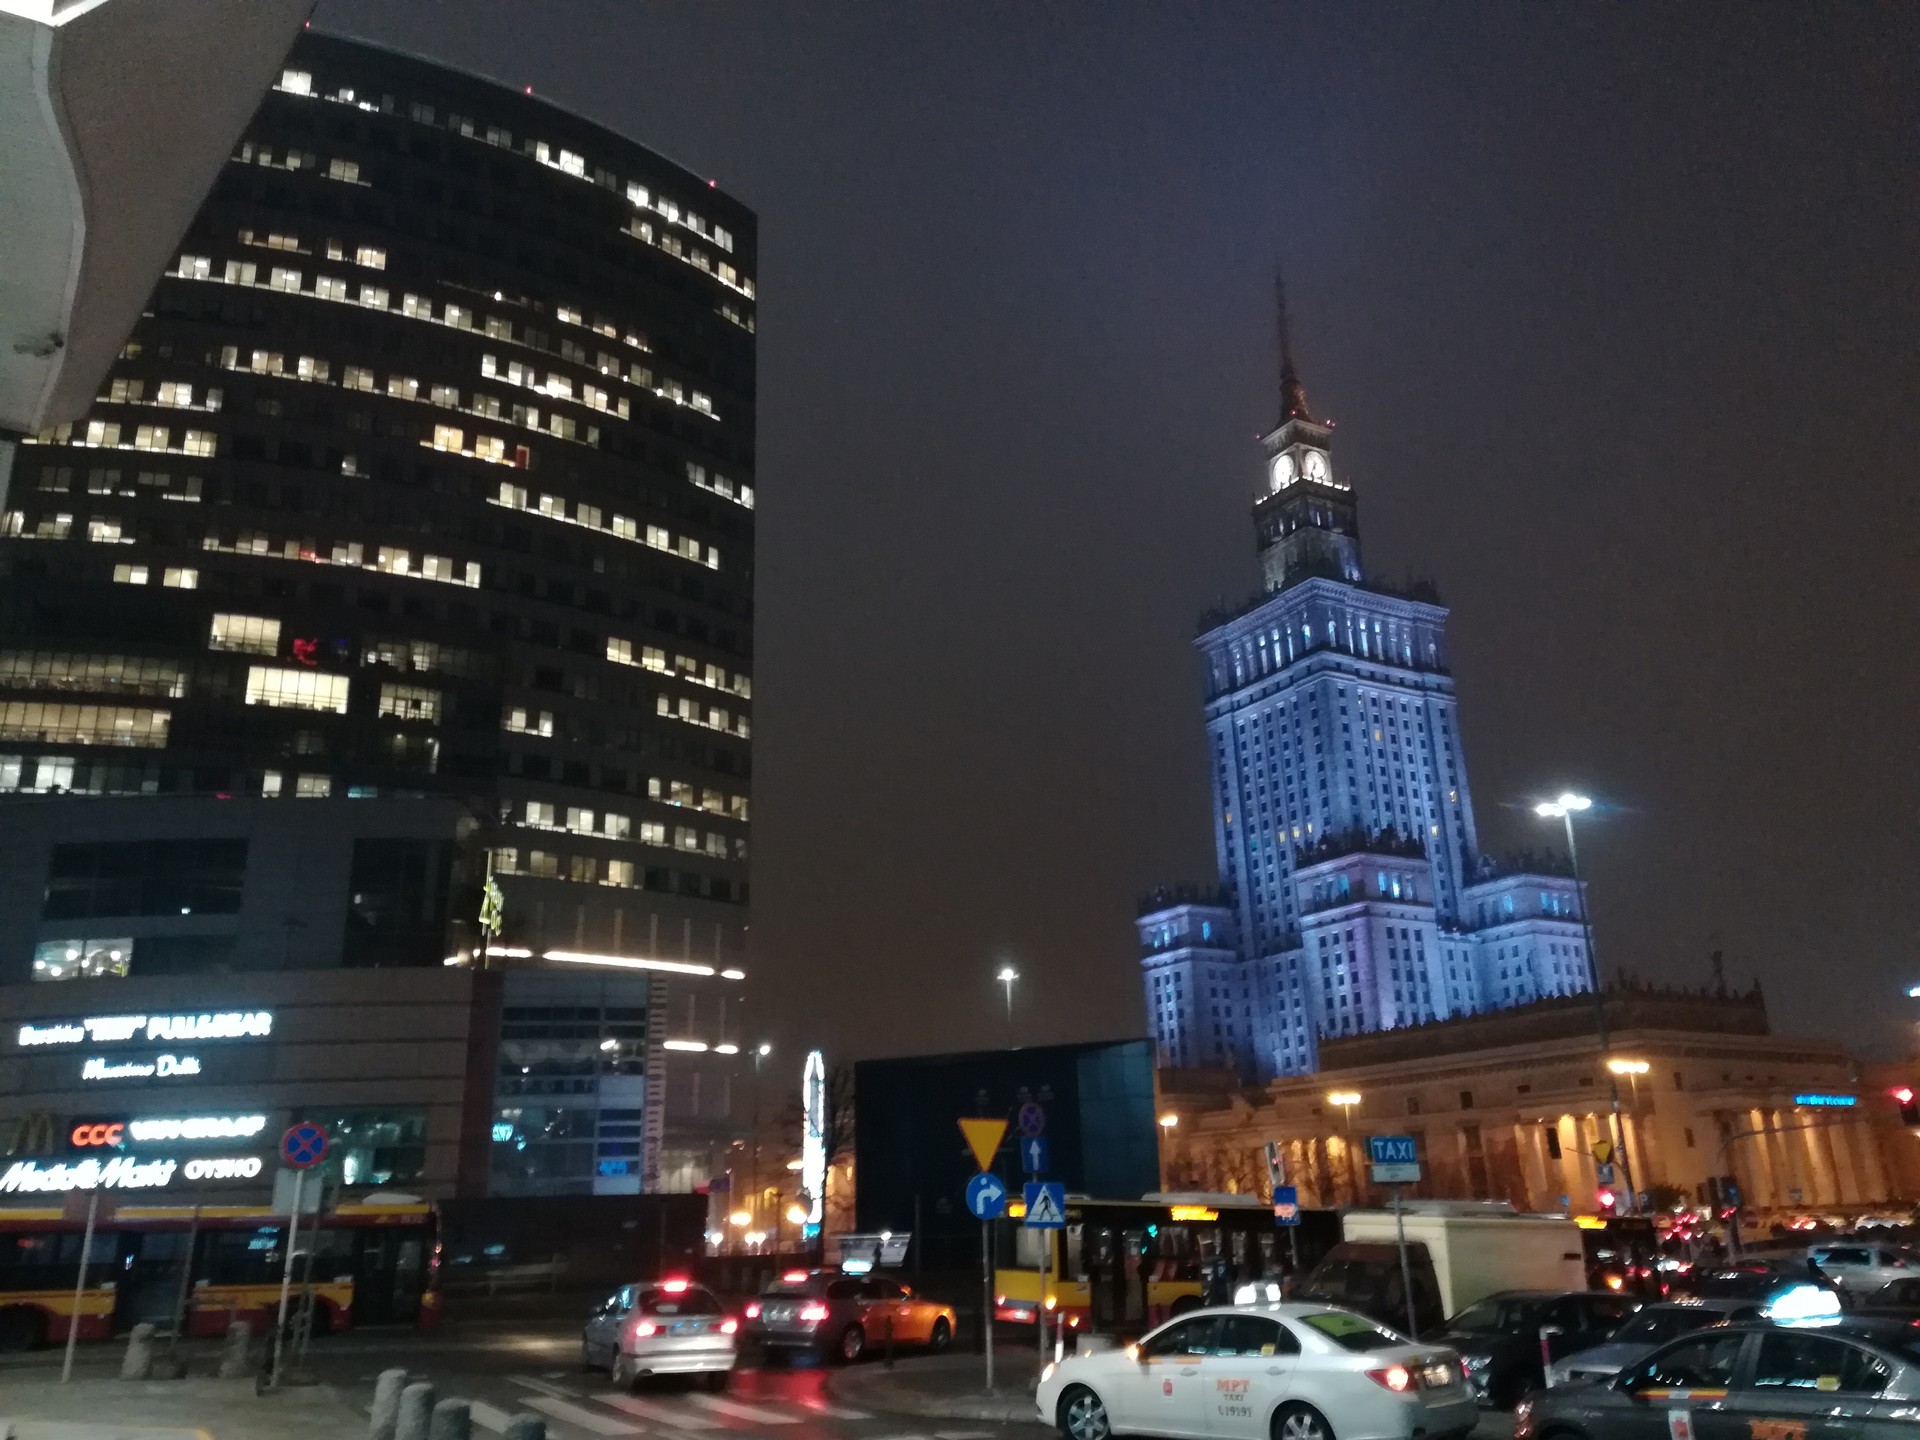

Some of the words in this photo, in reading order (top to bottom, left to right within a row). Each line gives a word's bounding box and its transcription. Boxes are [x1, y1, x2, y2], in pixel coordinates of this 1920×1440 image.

[71, 1122, 124, 1147] CCC
[1373, 1141, 1413, 1160] TAXI
[1216, 1377, 1249, 1392] MPT
[1223, 1393, 1244, 1402] TAXI
